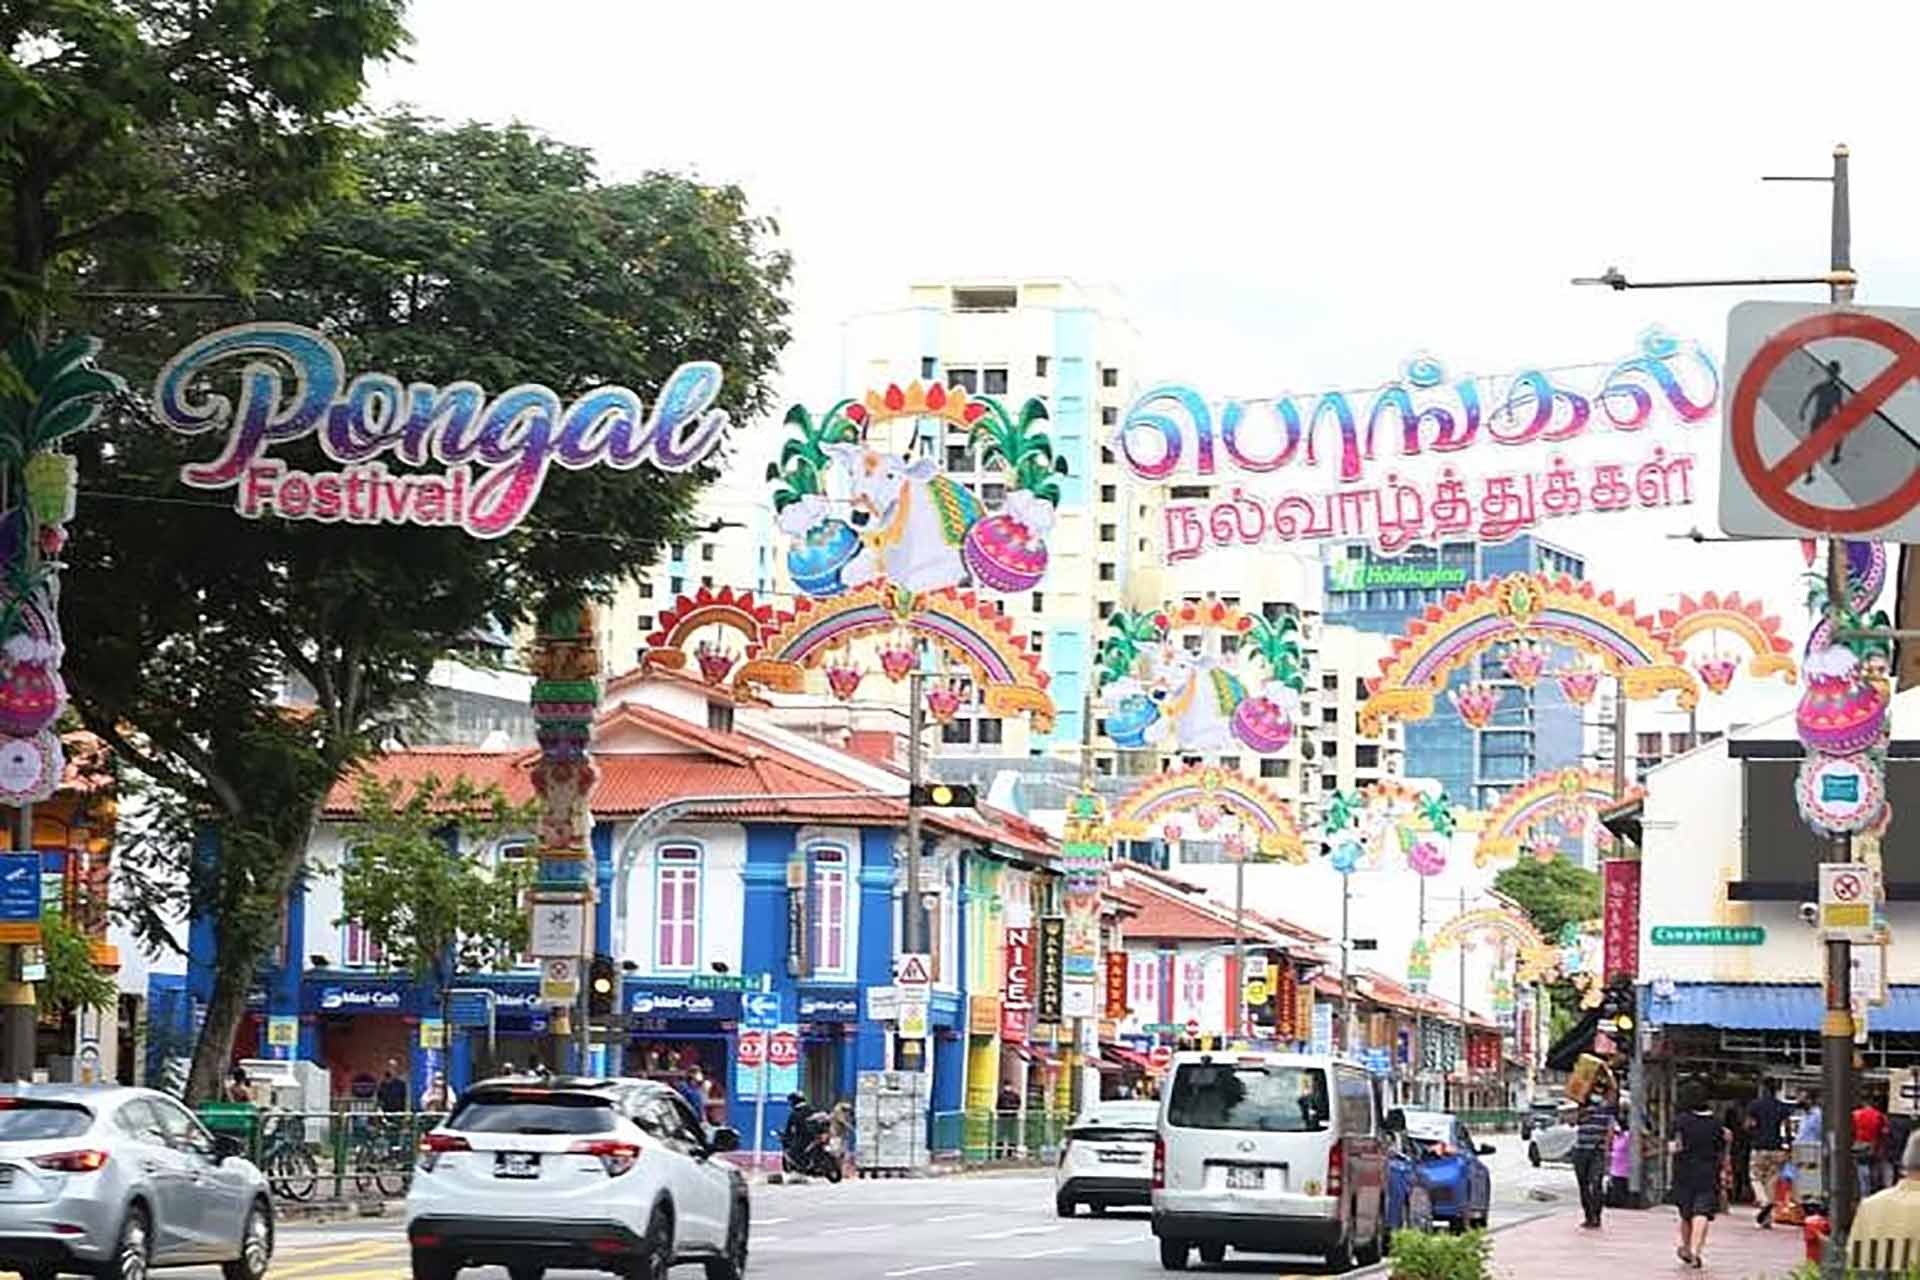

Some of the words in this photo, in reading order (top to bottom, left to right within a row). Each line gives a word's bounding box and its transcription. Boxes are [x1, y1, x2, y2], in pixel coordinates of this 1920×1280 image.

[156, 322, 727, 538] Pongal
[1121, 328, 1720, 482] பொங்கல்
[240, 459, 467, 524] Festival
[1163, 447, 1694, 565] நல்வாழ்த்துக்கள்
[1009, 930, 1028, 1001] NICE
